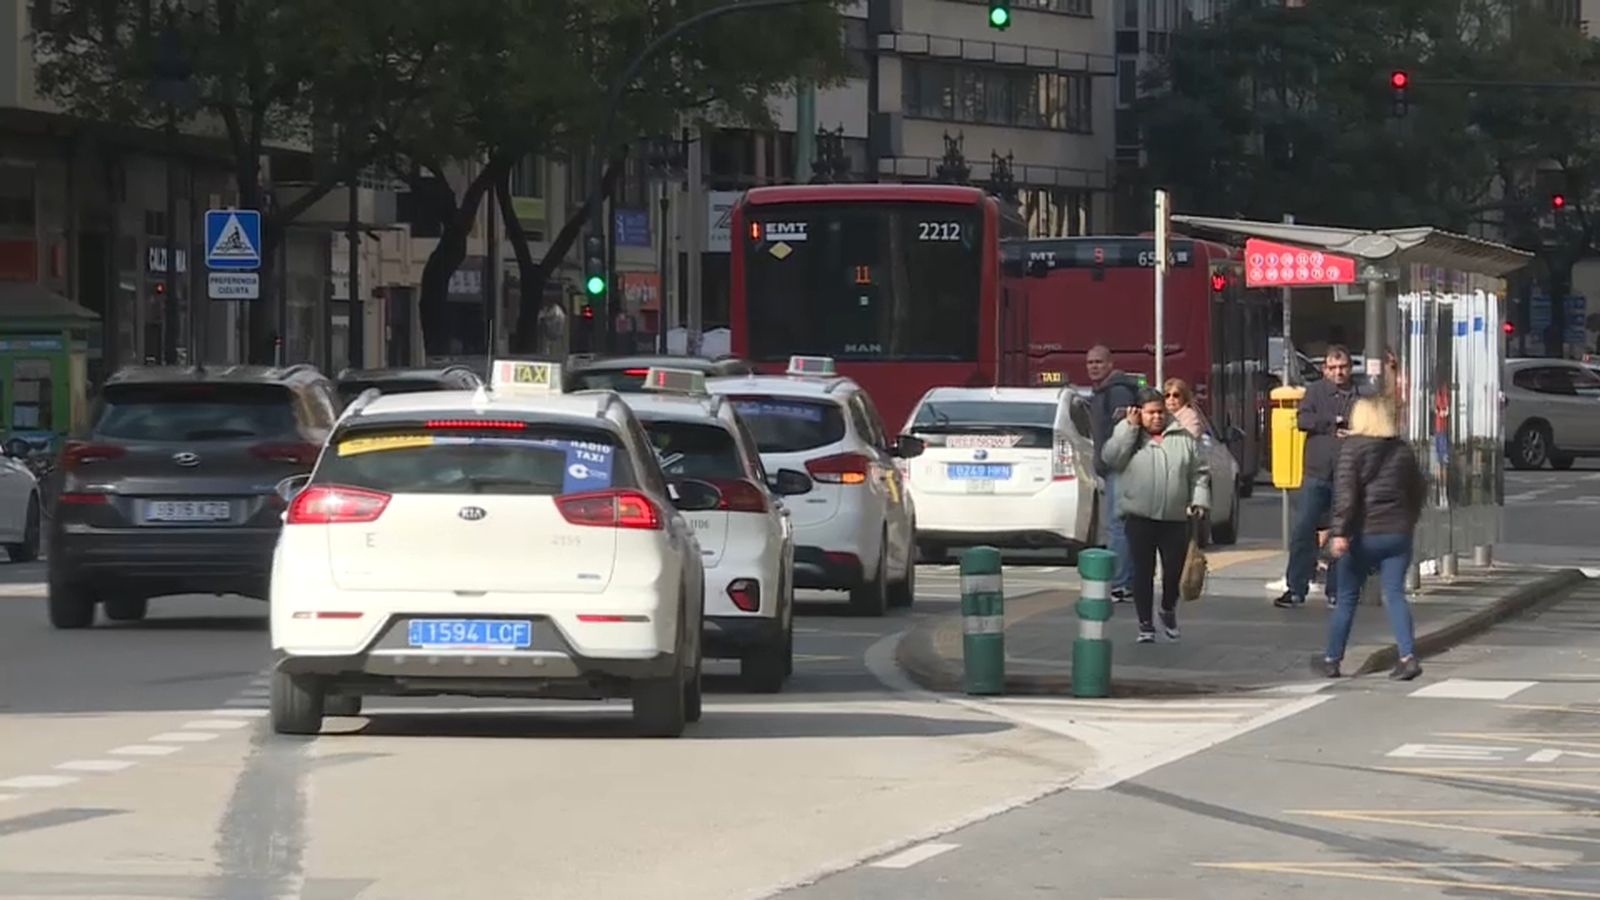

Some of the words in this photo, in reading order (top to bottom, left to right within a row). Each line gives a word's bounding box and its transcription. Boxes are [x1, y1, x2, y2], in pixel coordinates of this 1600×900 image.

[766, 222, 808, 234] EMT
[919, 222, 961, 241] 2212
[210, 276, 257, 285] PREFERENCIA
[855, 266, 872, 284] 11
[1041, 372, 1062, 383] TAXI
[571, 440, 610, 454] RADIO
[576, 450, 605, 464] TAXI
[461, 508, 483, 518] KIA
[366, 532, 376, 548] E
[428, 622, 480, 642] 1594
[485, 622, 528, 643] LCF
